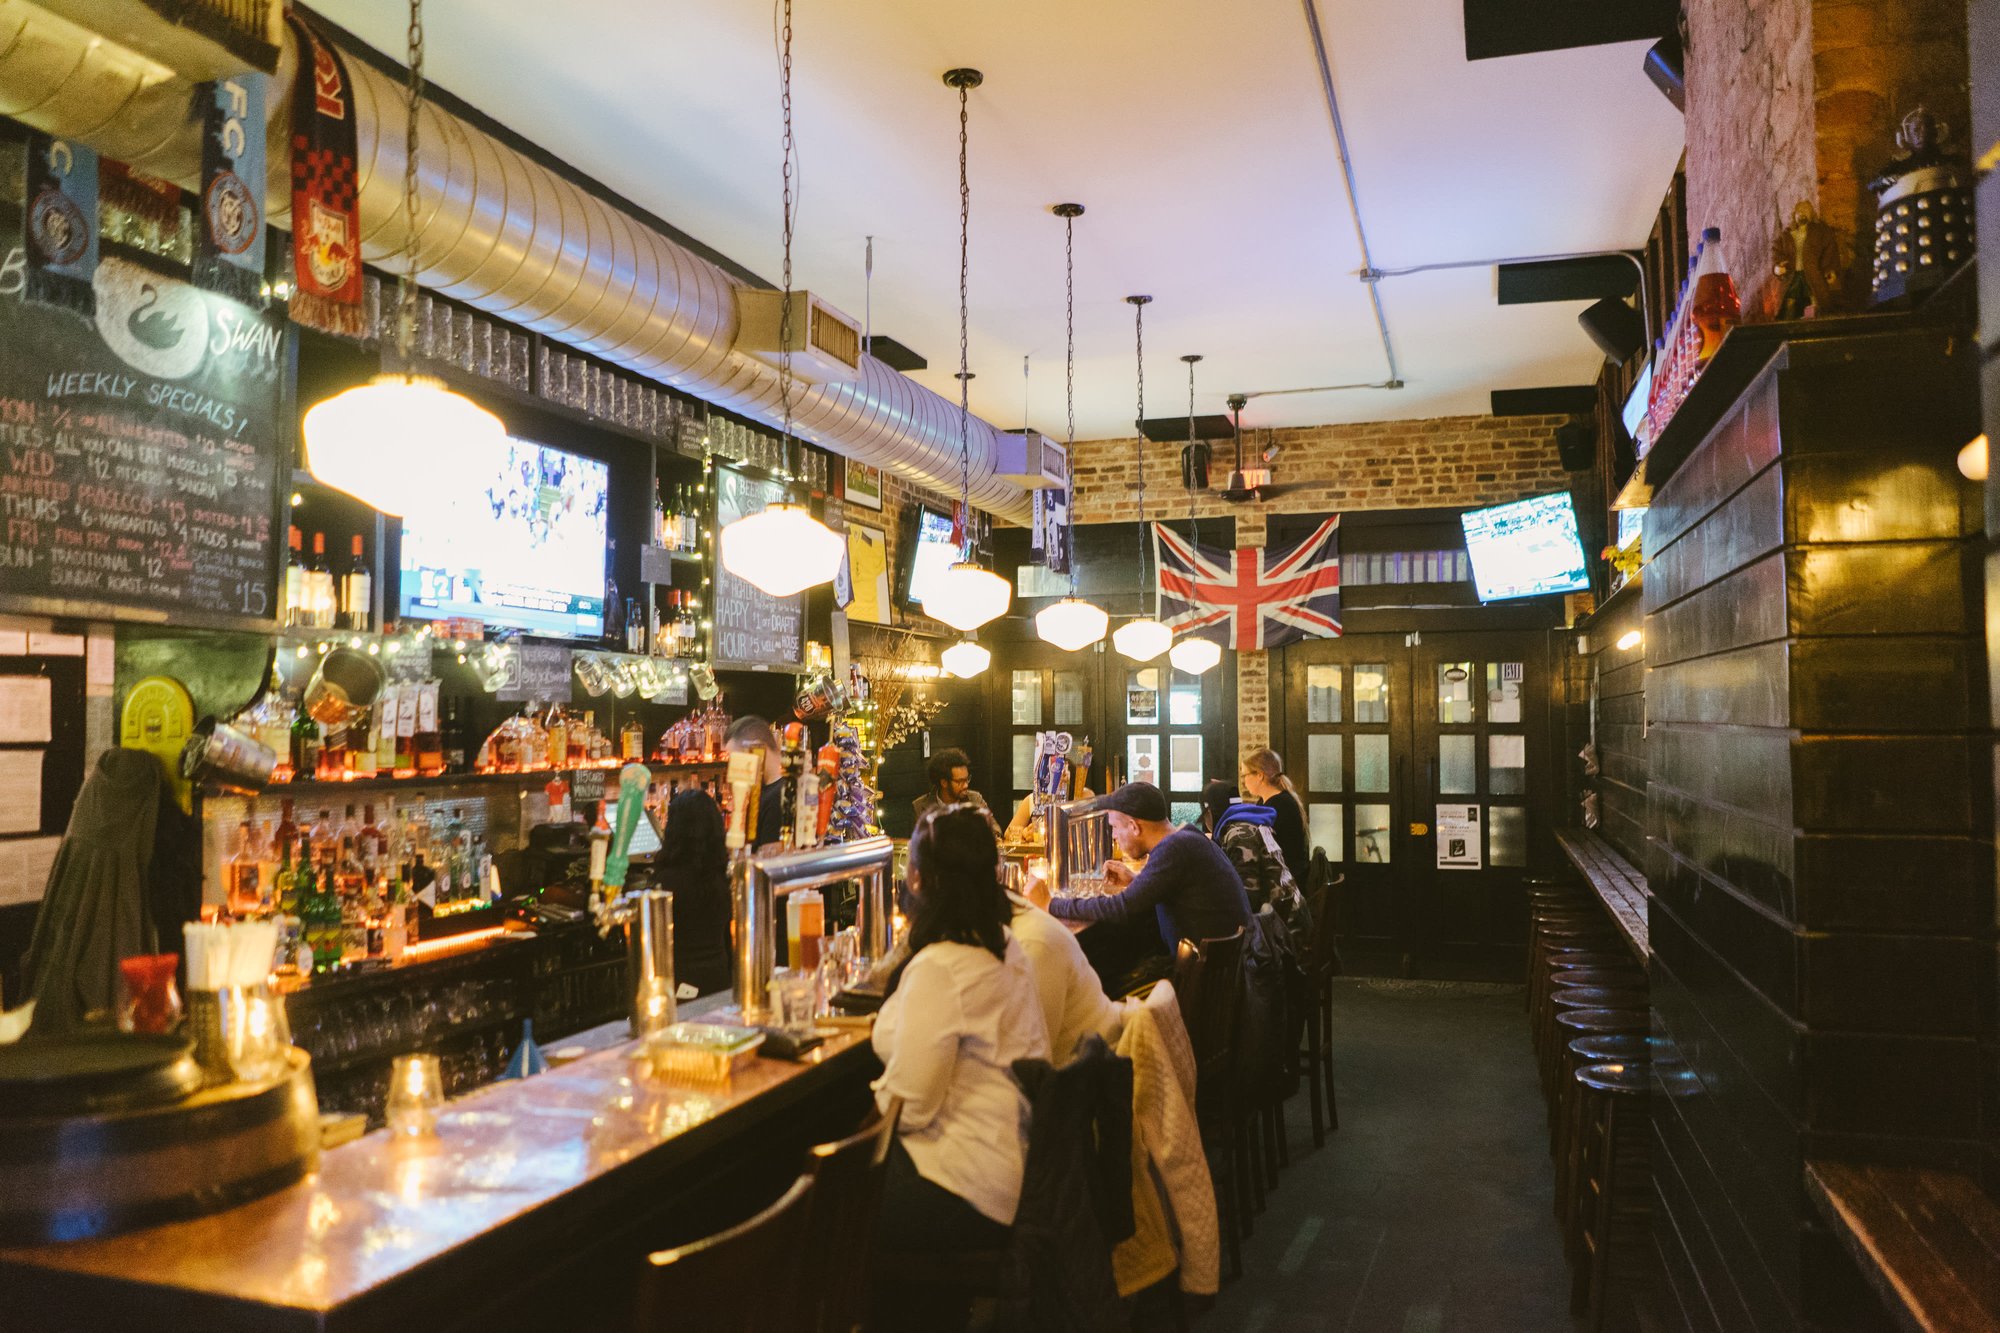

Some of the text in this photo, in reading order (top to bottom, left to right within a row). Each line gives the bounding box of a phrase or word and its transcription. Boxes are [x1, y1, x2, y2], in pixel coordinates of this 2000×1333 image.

[222, 81, 248, 158] FC
[51, 140, 74, 177] C
[47, 372, 137, 398] WEEKLY
[236, 580, 268, 615] $15
[716, 597, 749, 630] HAPPY
[771, 613, 796, 634] DRAFT
[718, 631, 747, 659] HOUR
